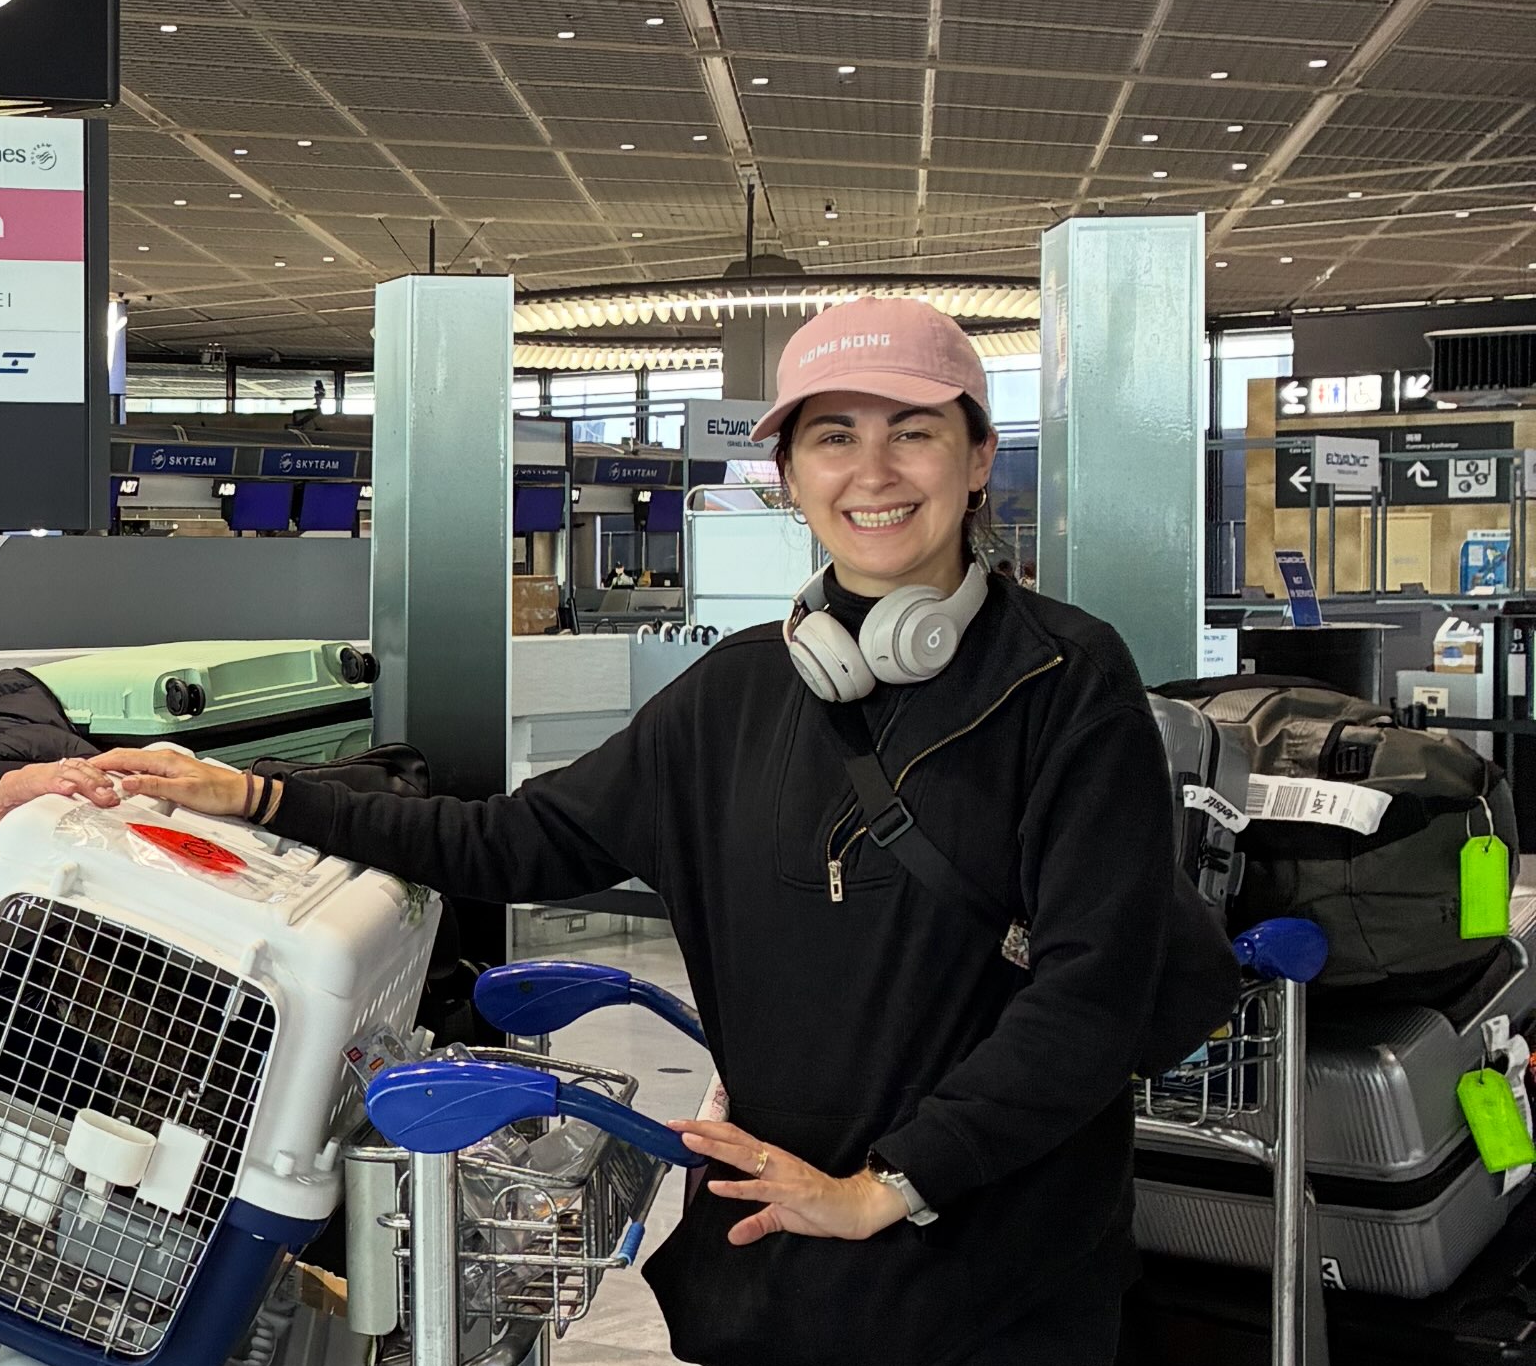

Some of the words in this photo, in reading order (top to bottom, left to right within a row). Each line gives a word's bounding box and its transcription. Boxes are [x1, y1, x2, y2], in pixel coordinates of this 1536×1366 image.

[799, 340, 838, 368] HOME
[840, 332, 891, 352] KONG
[168, 455, 217, 467] SKYTEAM
[295, 458, 340, 470] SKYTEAM
[1310, 789, 1329, 816] NRT
